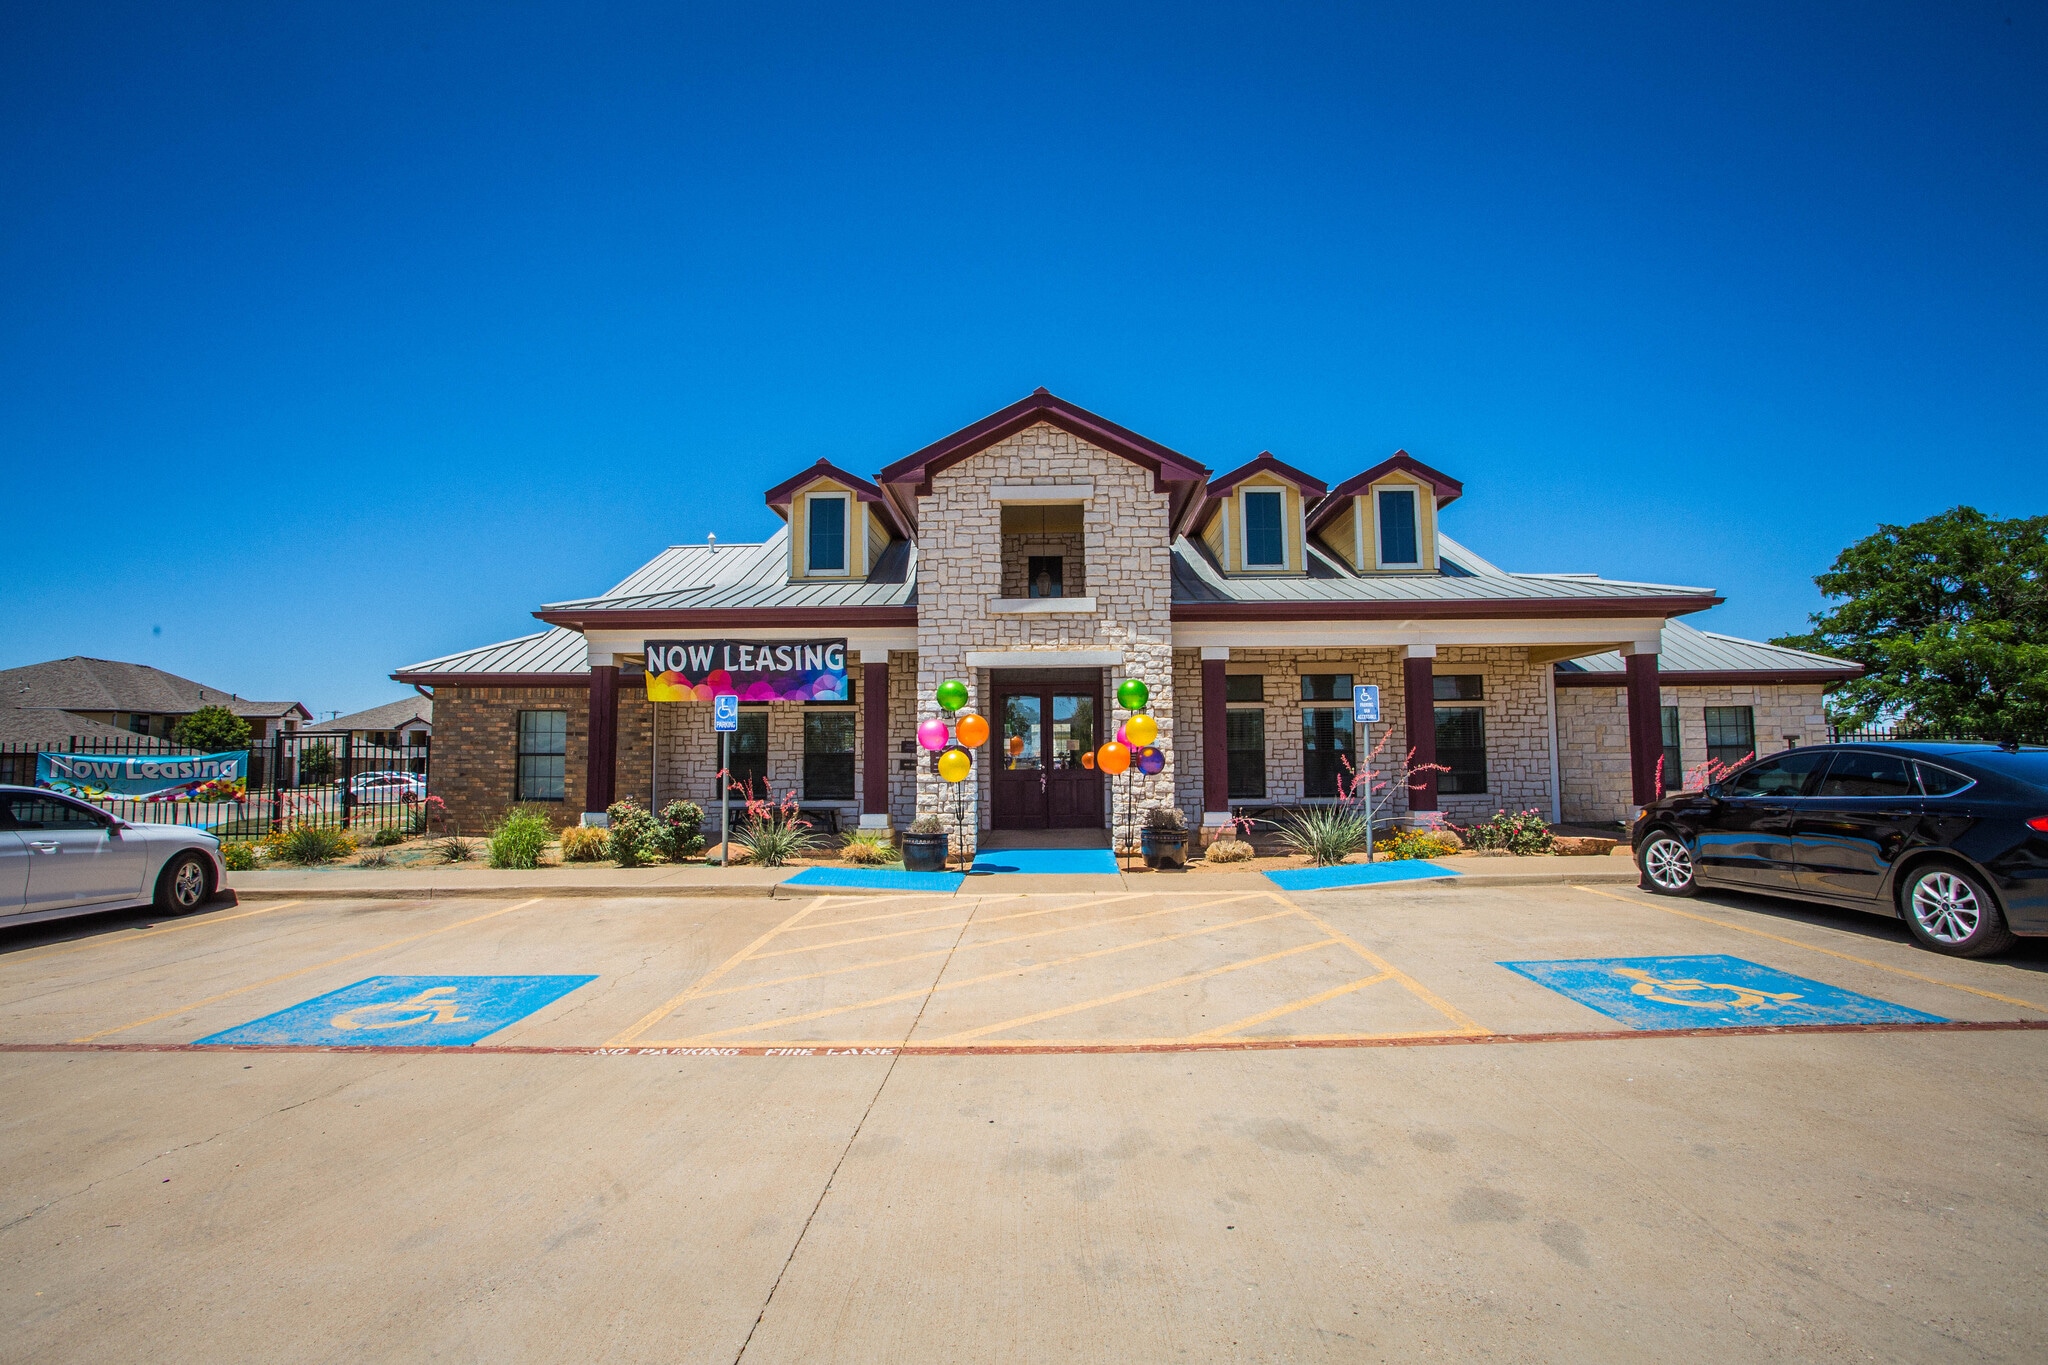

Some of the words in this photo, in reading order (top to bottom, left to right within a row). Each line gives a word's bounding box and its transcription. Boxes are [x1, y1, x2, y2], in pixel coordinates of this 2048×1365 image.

[647, 645, 715, 673] NOW
[723, 644, 845, 673] LEASING
[50, 756, 121, 779] Now
[125, 757, 239, 783] Leasing
[593, 1047, 631, 1056] NO
[637, 1047, 742, 1056] PARKING
[764, 1047, 818, 1056] FIRE
[825, 1047, 897, 1056] LANE
